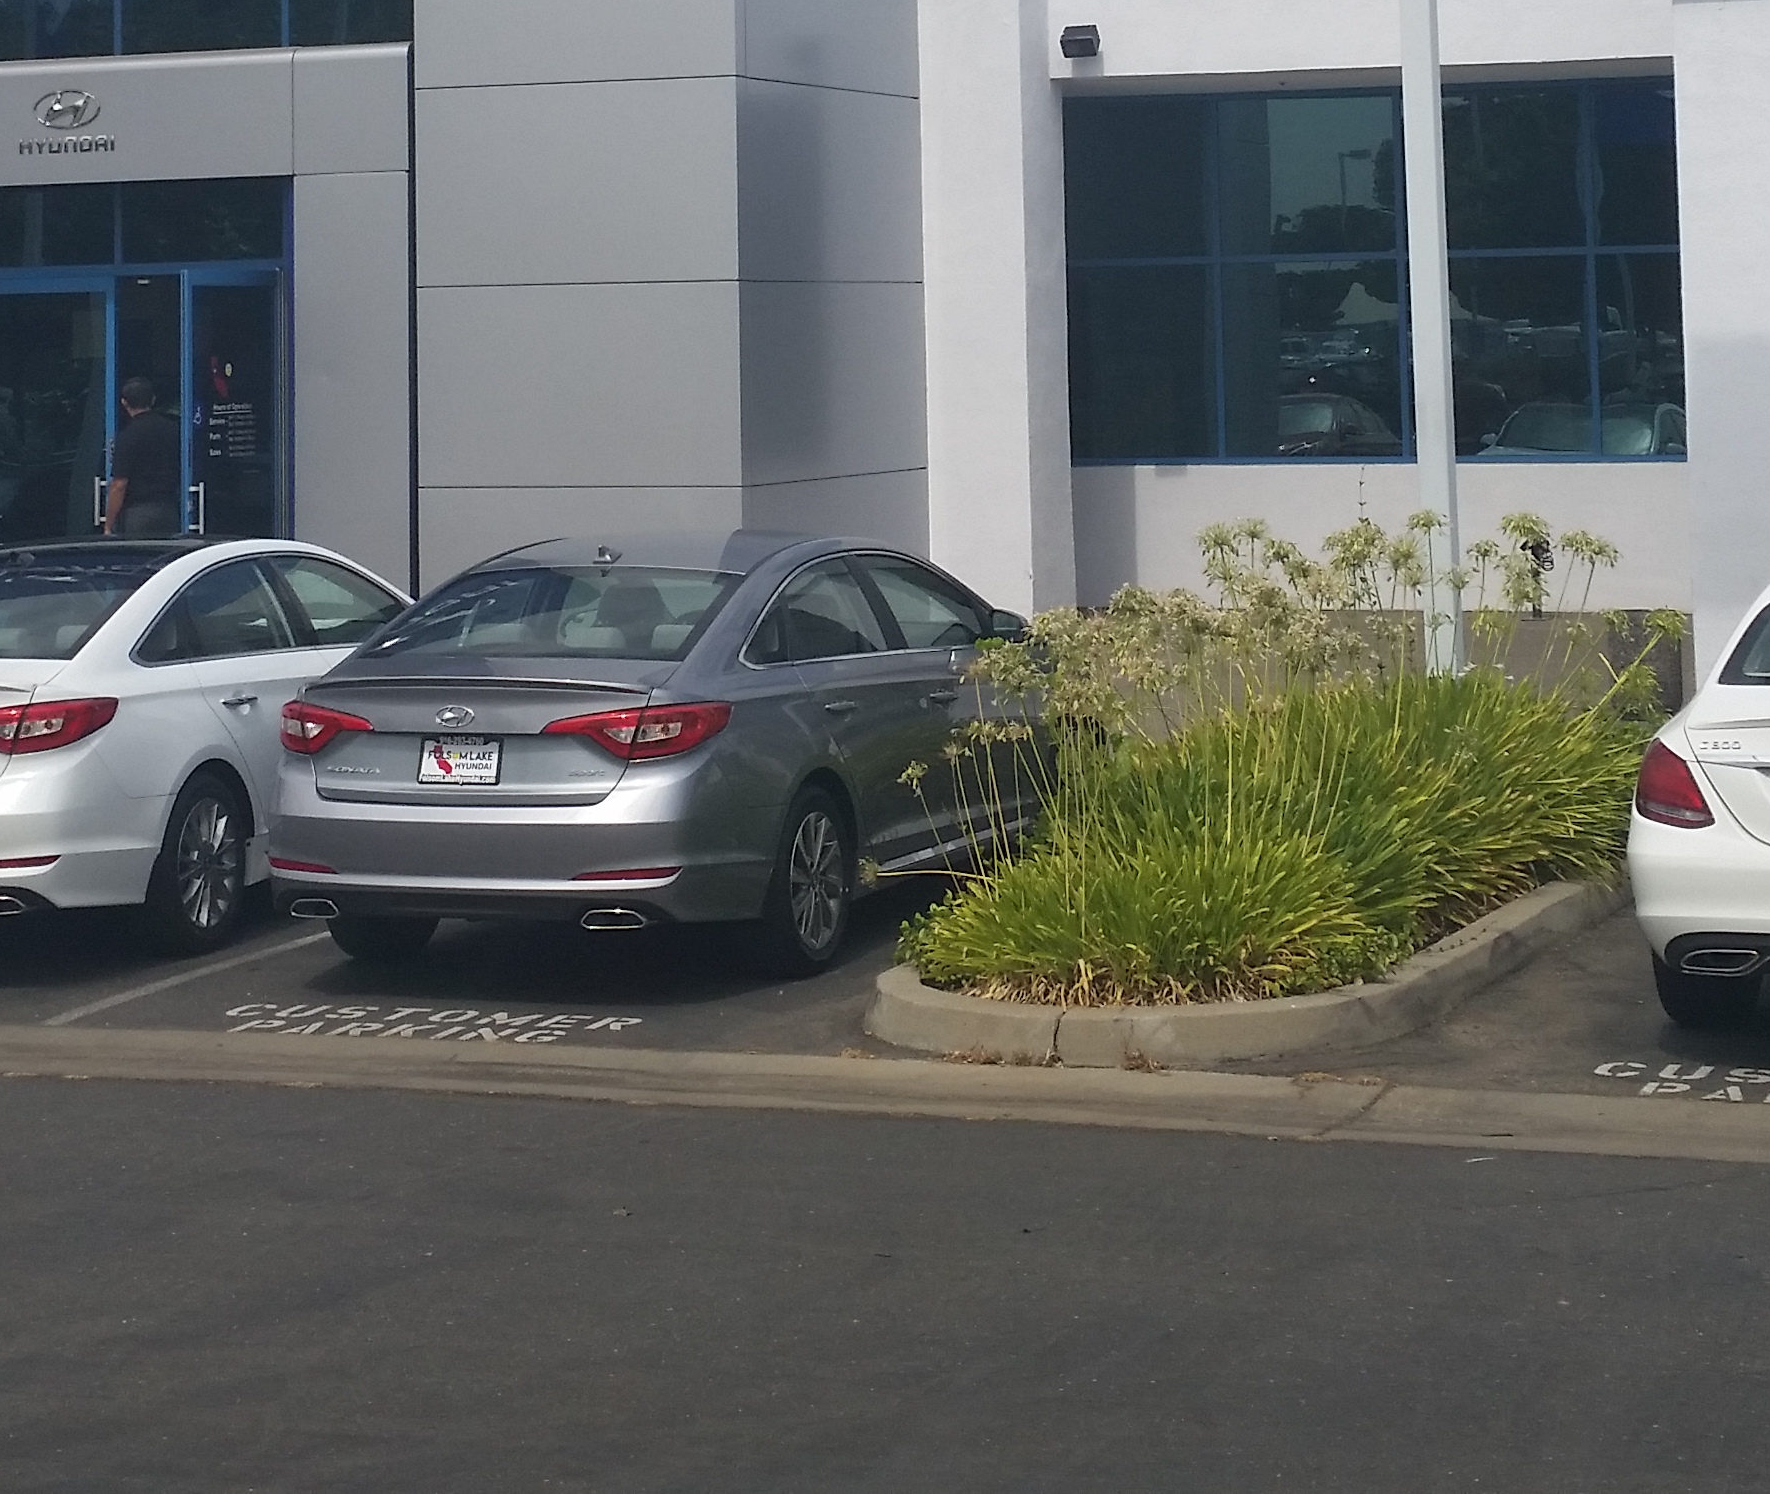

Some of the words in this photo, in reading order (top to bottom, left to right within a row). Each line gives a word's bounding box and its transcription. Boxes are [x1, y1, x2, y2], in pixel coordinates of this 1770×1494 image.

[19, 134, 116, 156] HYUNDAI
[454, 762, 492, 770] HYUNDAI
[469, 750, 494, 761] LAKE
[225, 1003, 644, 1032] CUSTOMER
[227, 1018, 567, 1044] PARKING
